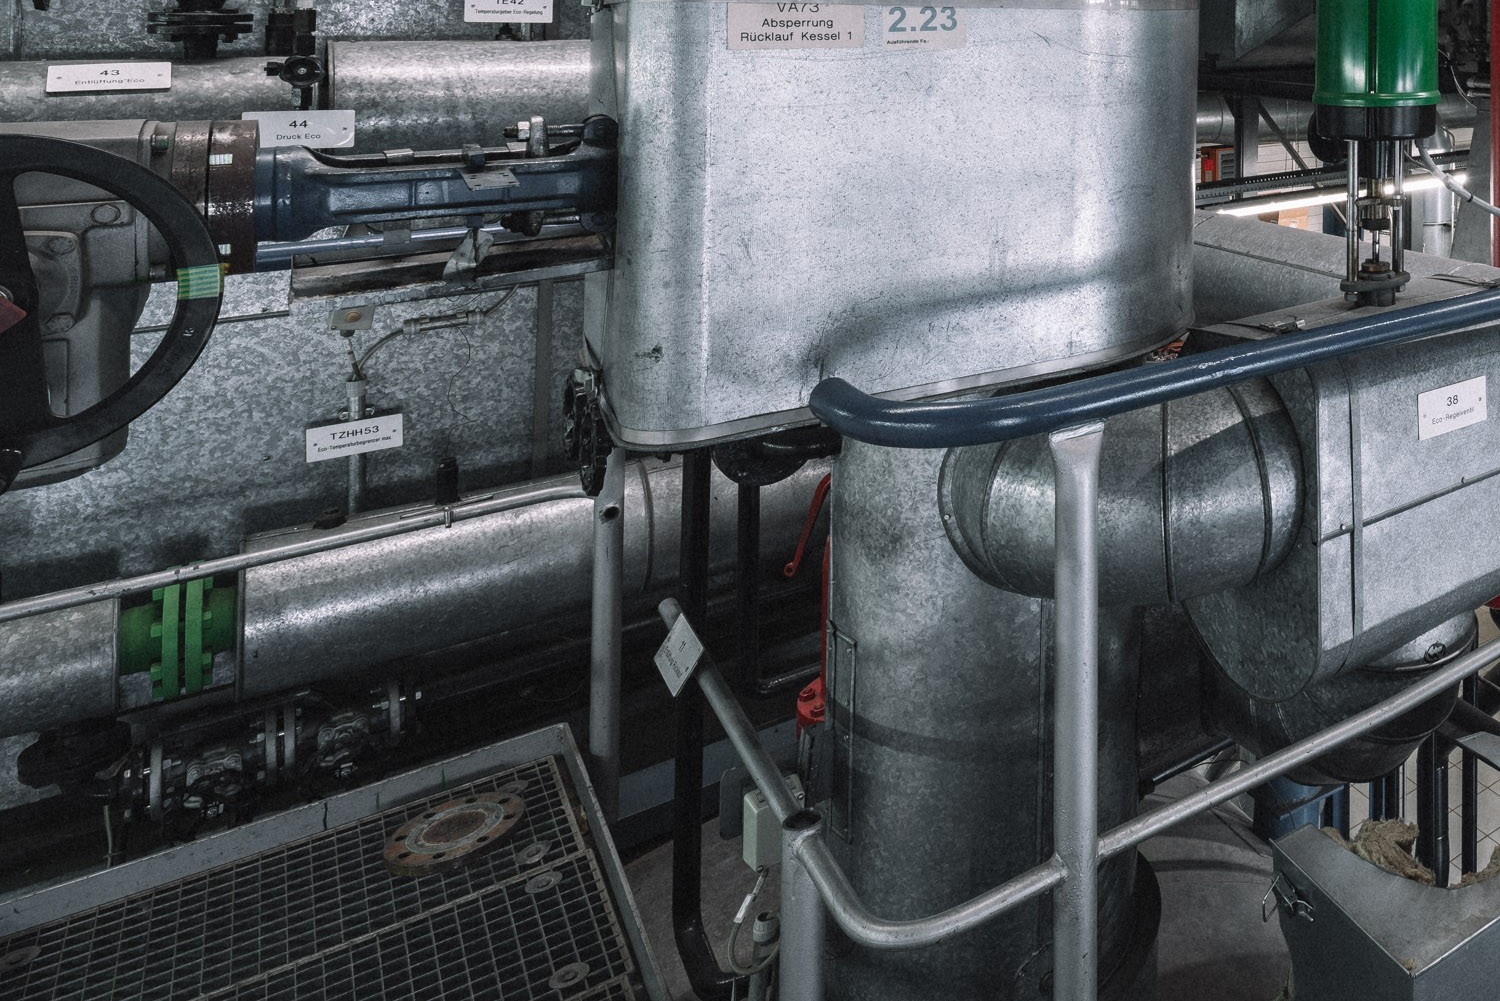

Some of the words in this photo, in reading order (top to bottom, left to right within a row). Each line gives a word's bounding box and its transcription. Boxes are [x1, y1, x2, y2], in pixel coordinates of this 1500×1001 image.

[762, 18, 833, 29] Absperrung
[888, 6, 958, 32] 2.23
[740, 32, 794, 41] Rücklauf
[801, 32, 840, 40] Kessel
[847, 31, 852, 40] 1
[289, 120, 308, 128] 44
[1446, 394, 1459, 407] 38
[330, 425, 380, 440] TZHH53
